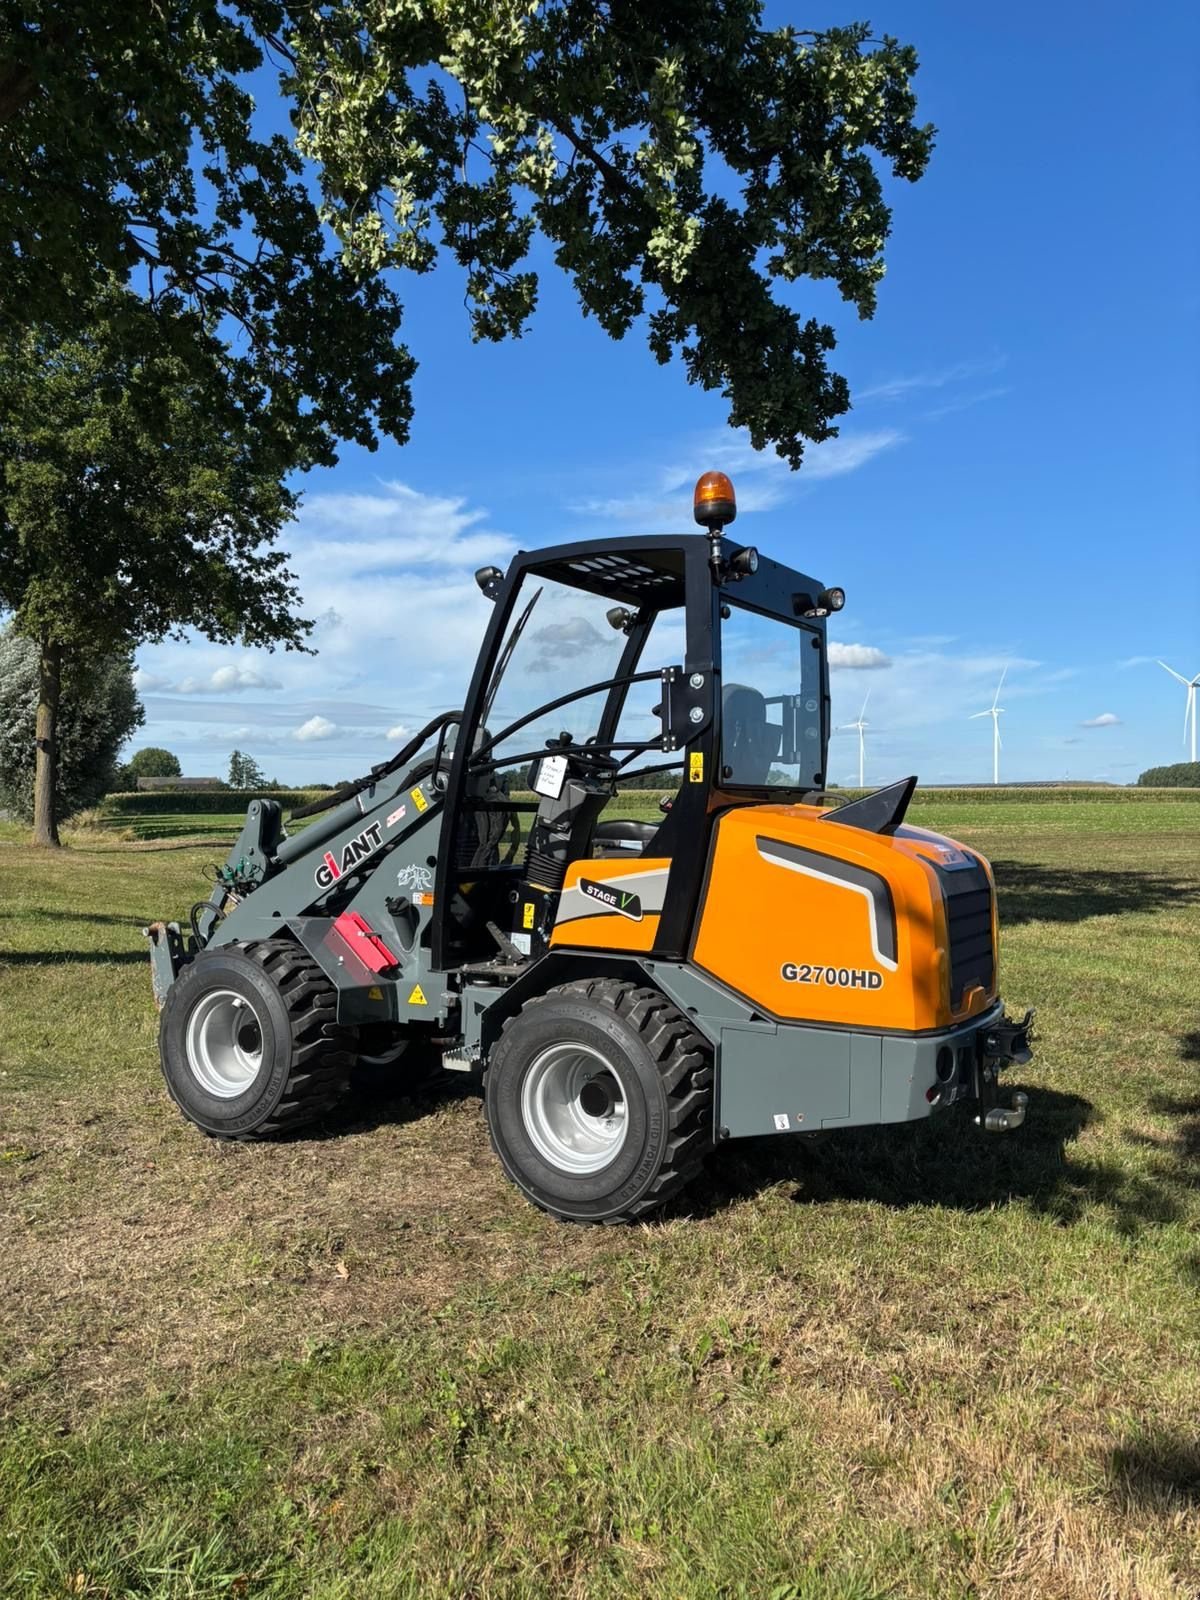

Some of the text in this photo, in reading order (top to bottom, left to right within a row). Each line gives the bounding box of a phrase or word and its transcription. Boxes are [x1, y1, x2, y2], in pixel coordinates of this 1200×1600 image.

[586, 885, 637, 909] STAGE V
[781, 962, 883, 990] G2700HD
[650, 1111, 661, 1139] SKID
[635, 1144, 657, 1182] POWER
